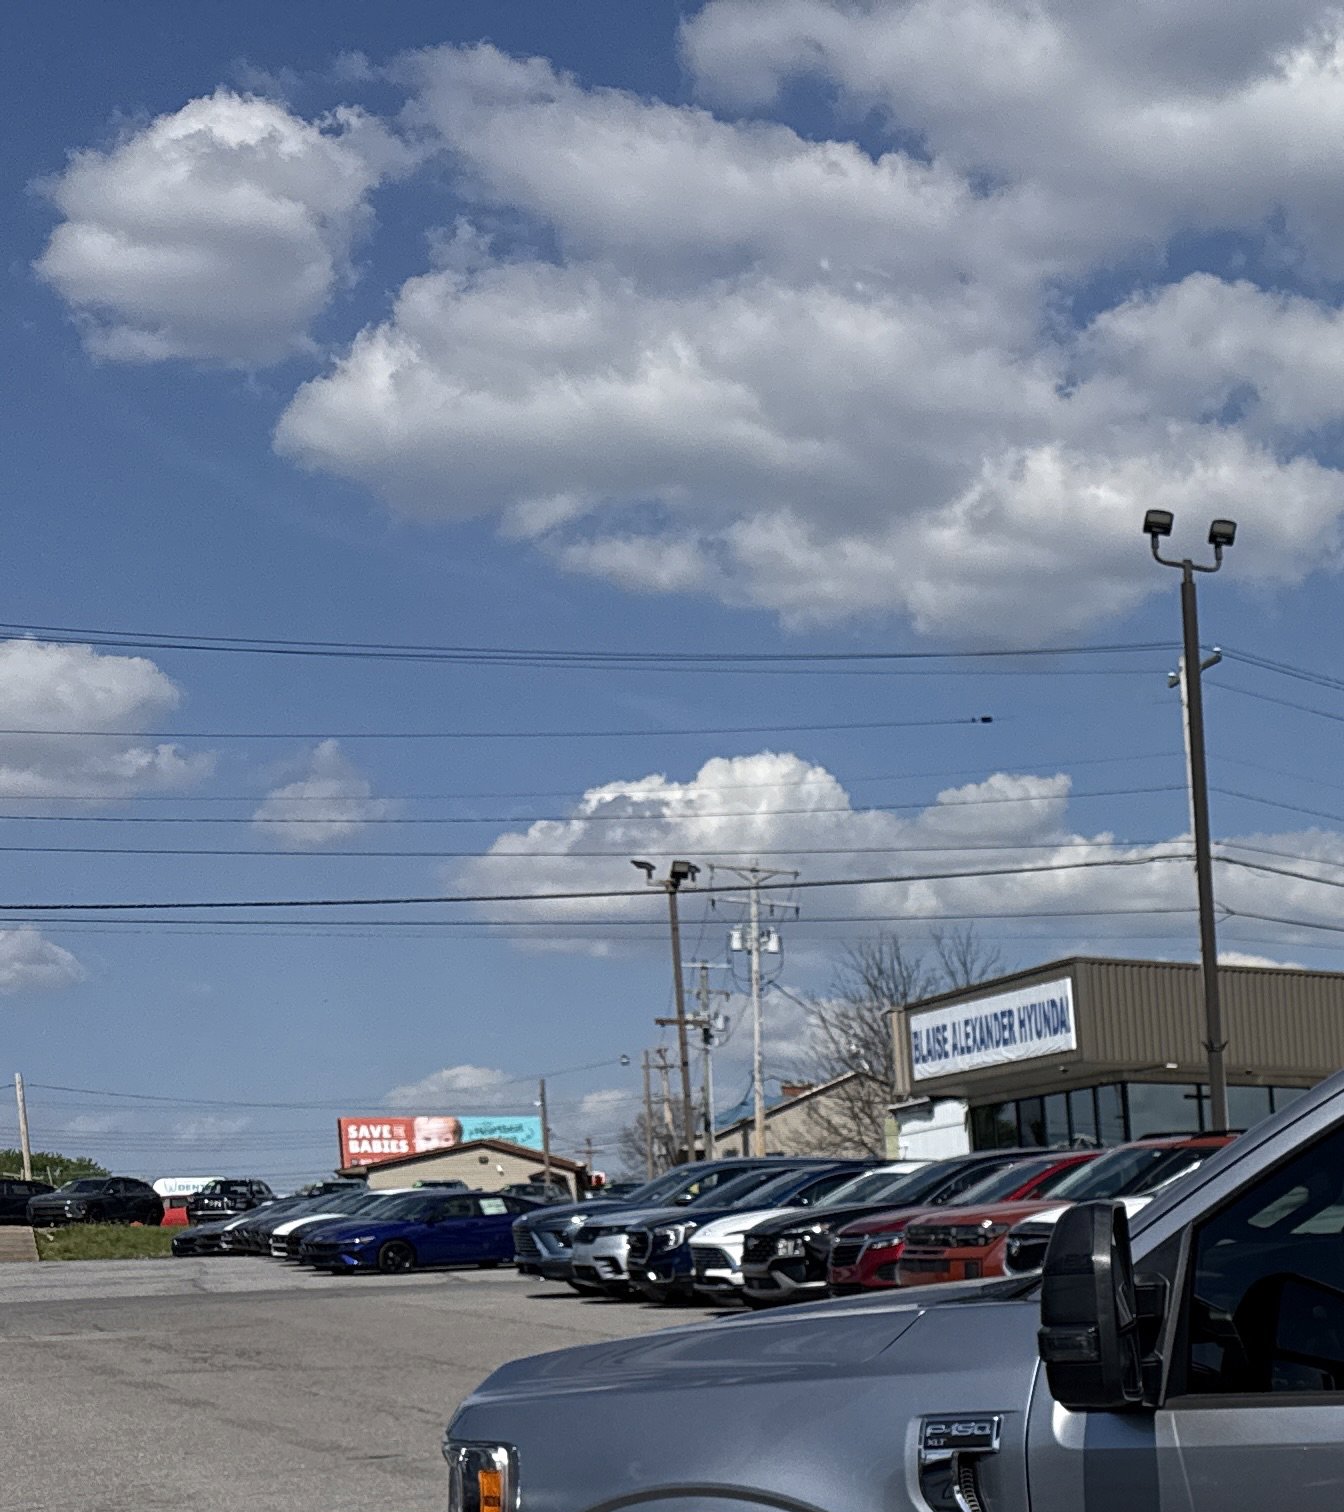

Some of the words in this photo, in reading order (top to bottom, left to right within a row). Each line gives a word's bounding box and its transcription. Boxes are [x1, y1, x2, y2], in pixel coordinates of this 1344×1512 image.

[912, 1024, 950, 1064] BLAISE
[952, 1009, 1017, 1057] ALEXANDER
[1018, 996, 1071, 1044] HYUNDAI
[347, 1124, 392, 1139] SAVE
[348, 1139, 410, 1153] BABIES
[927, 1438, 946, 1447] XLT
